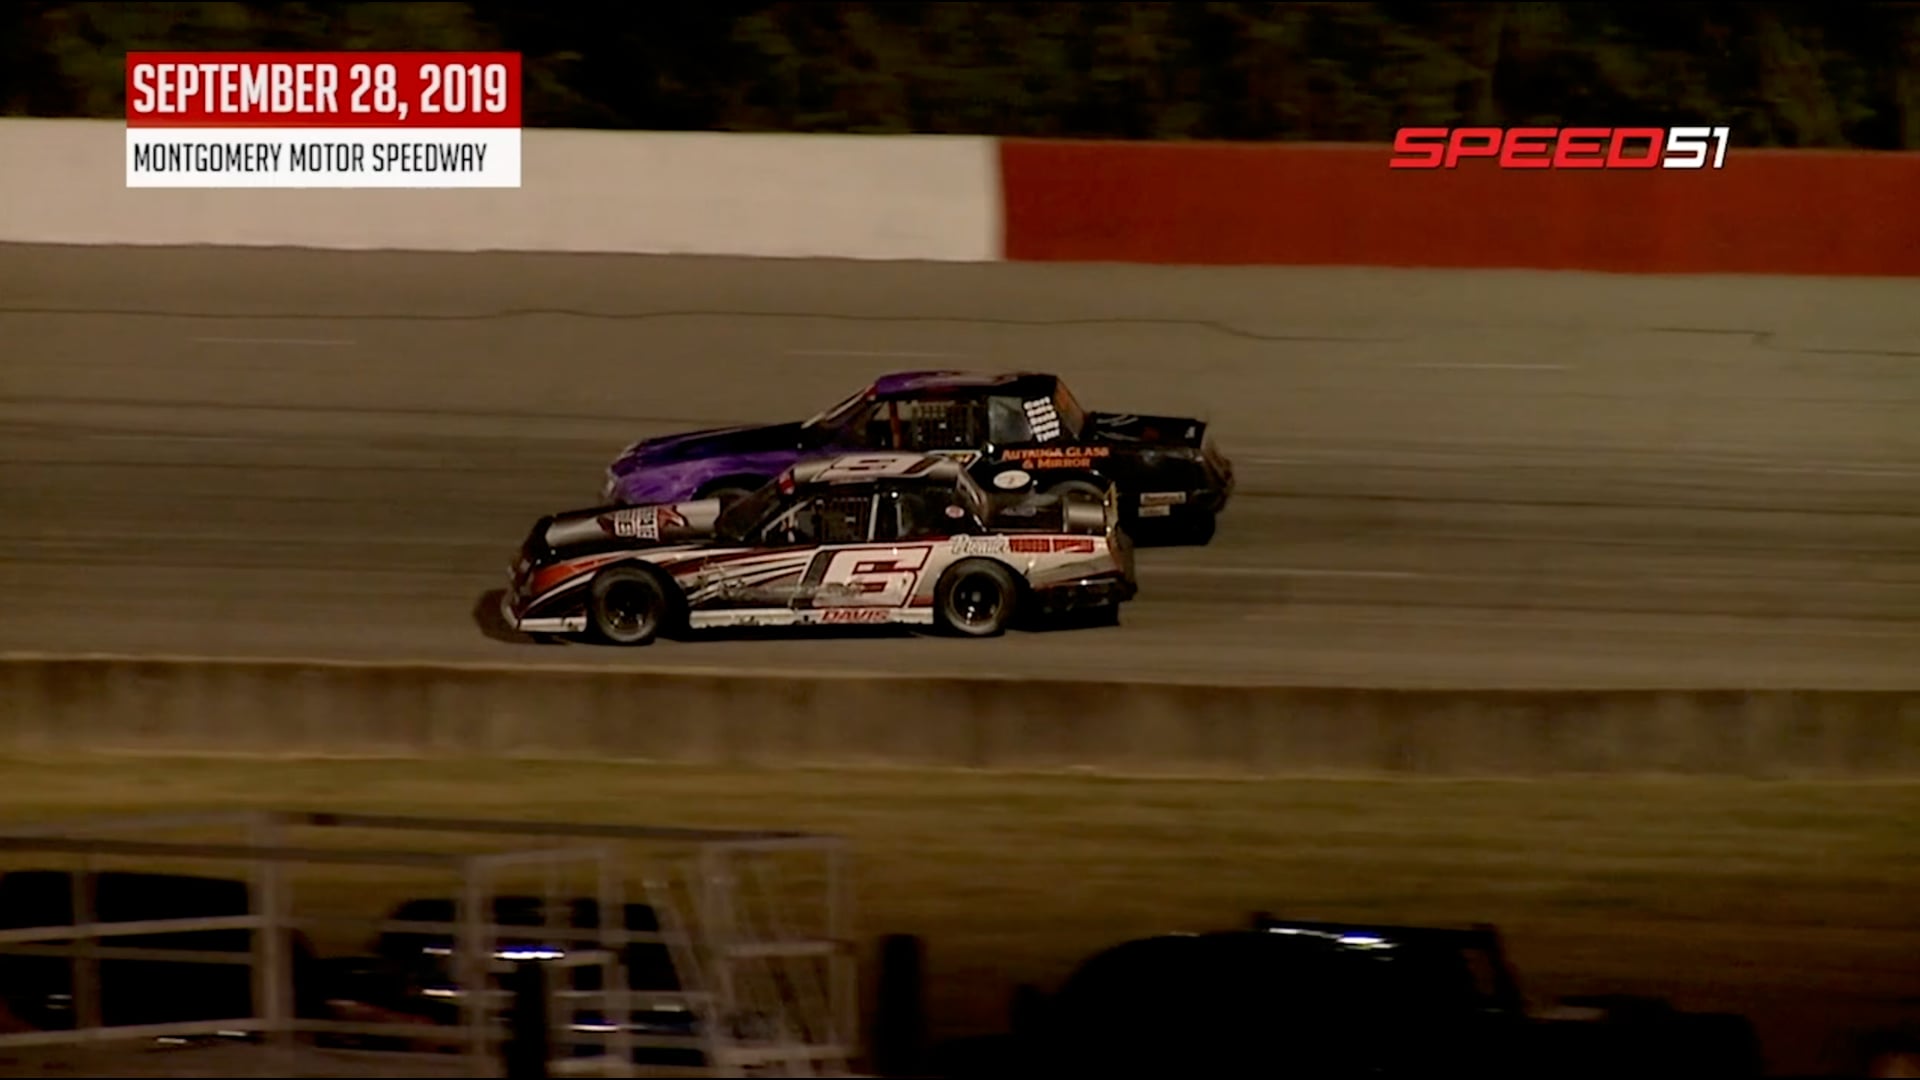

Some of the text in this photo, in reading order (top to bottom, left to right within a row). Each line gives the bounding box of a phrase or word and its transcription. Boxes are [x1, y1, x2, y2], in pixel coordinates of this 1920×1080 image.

[1036, 457, 1091, 470] MIRROR
[812, 545, 933, 608] 6
[821, 609, 890, 622] DAVIS
